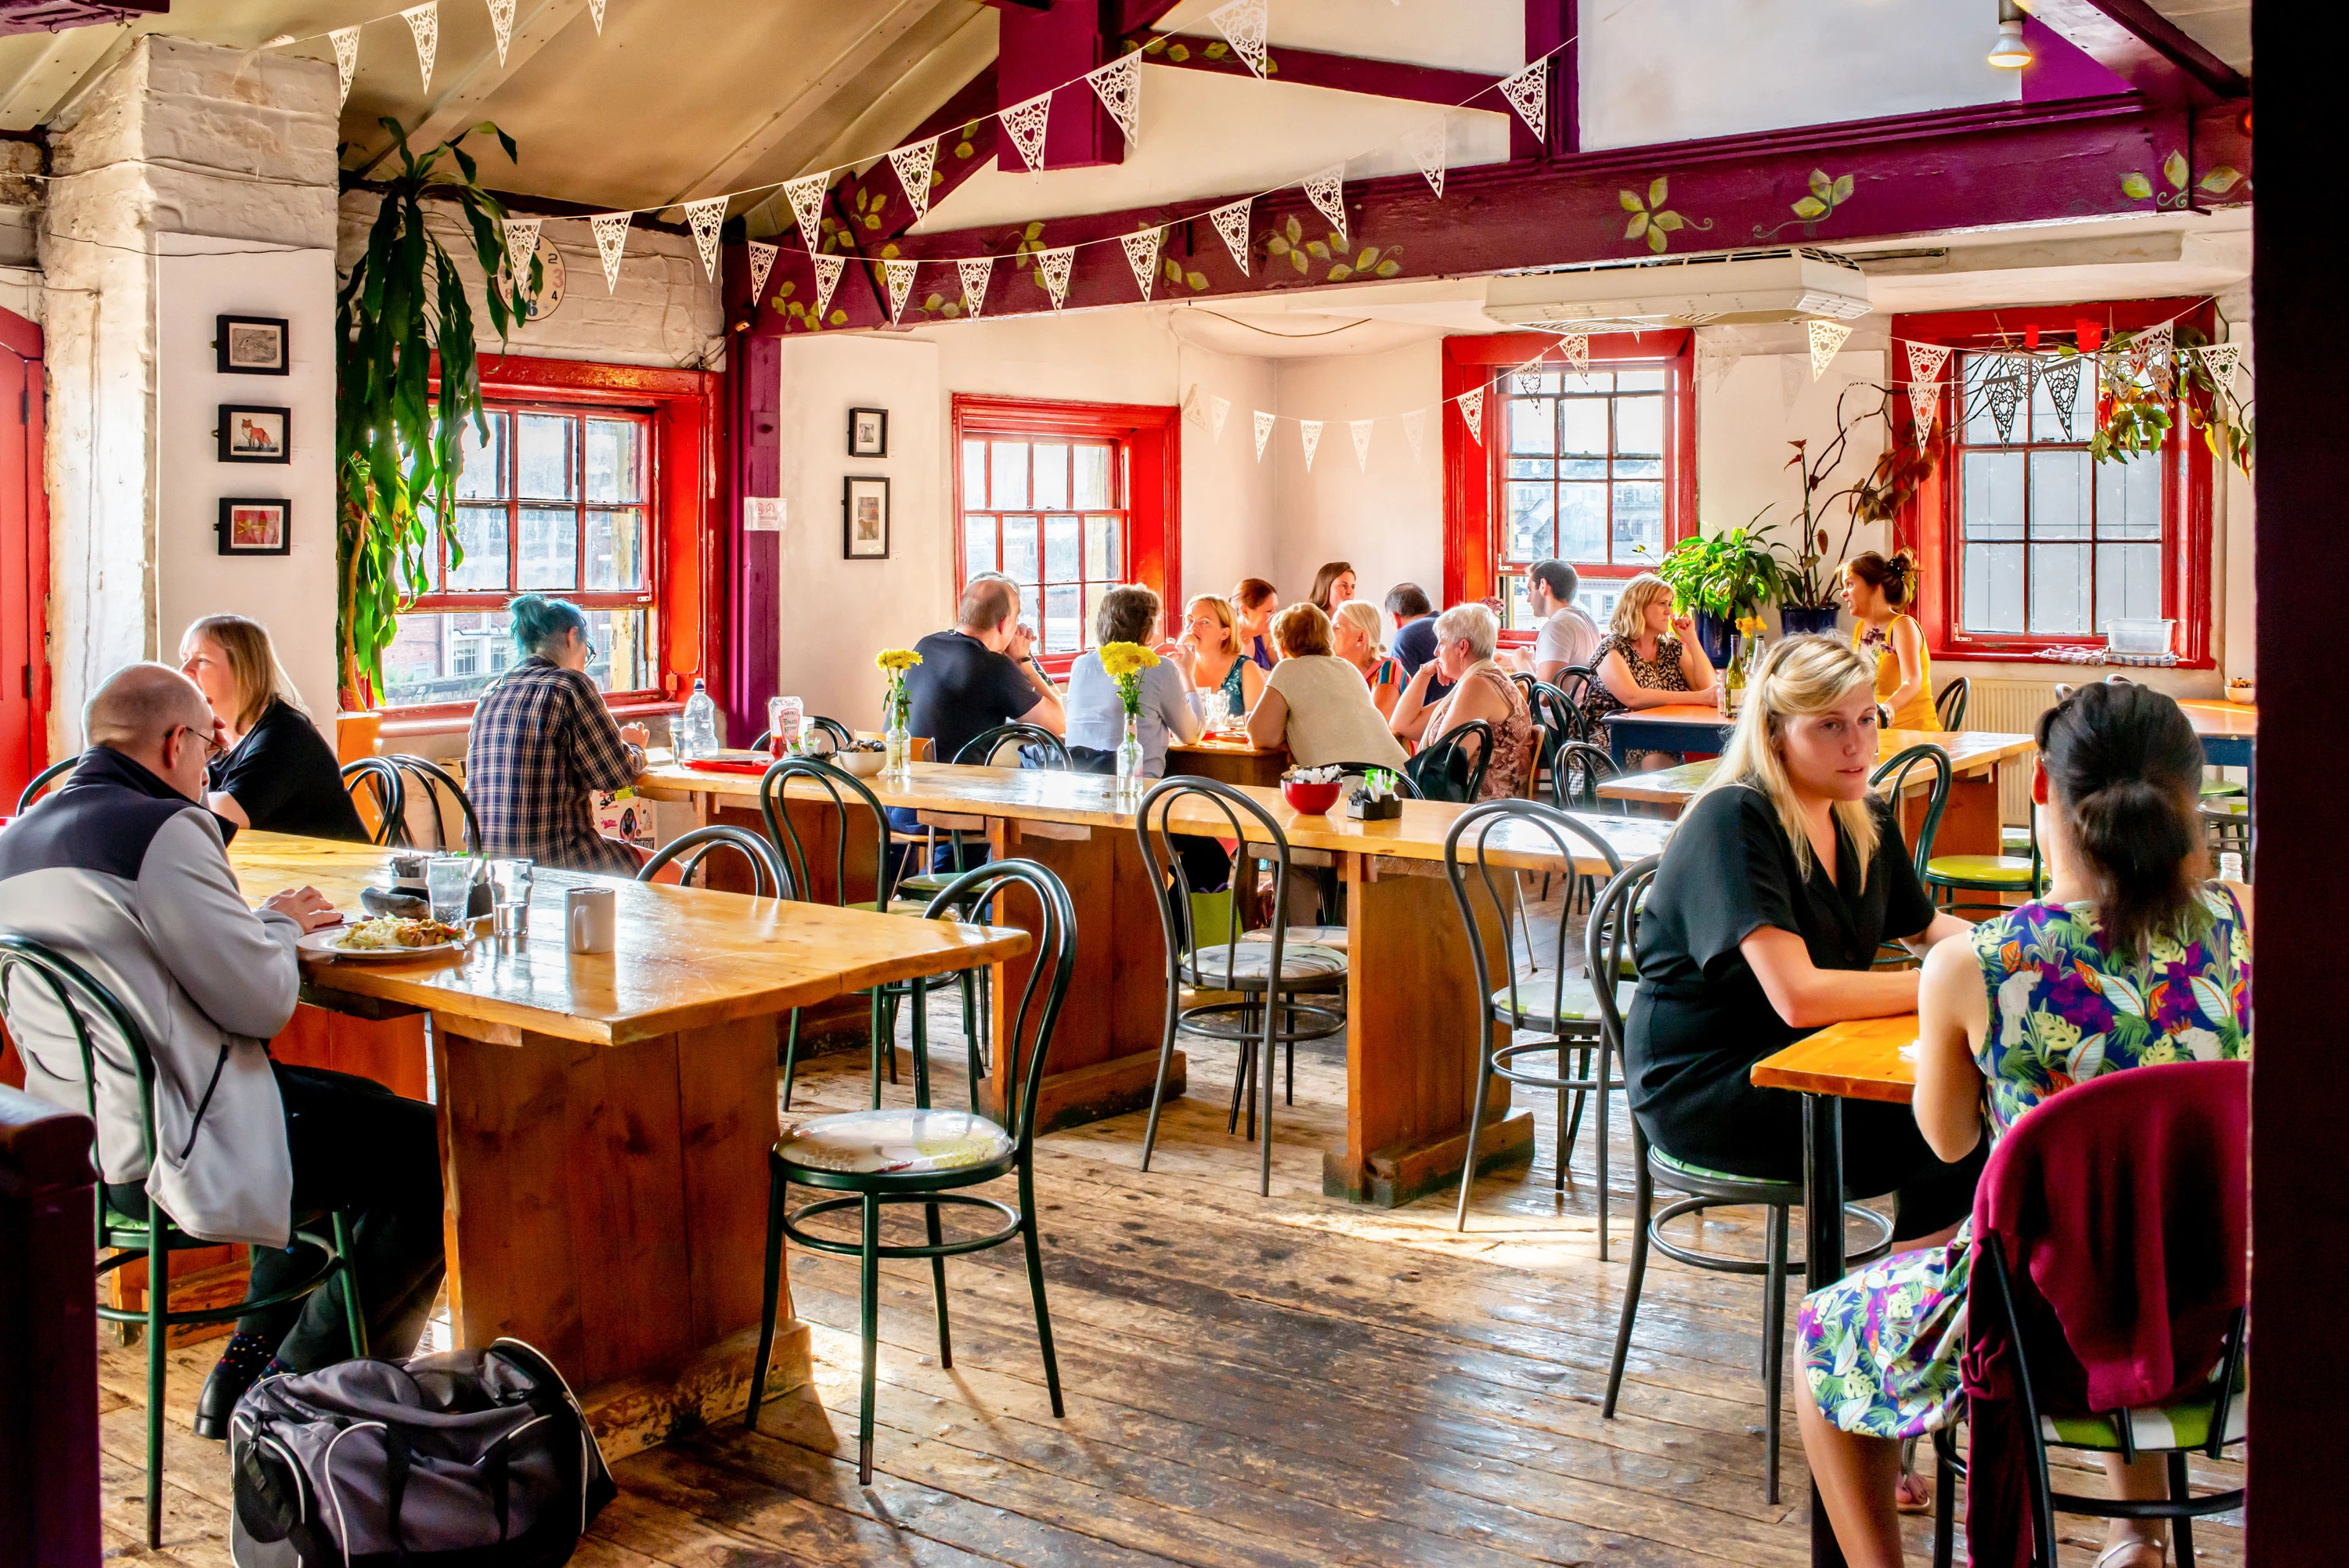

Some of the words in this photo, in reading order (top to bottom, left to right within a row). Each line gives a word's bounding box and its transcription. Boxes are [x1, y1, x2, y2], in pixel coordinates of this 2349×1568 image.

[548, 253, 558, 265] 2
[552, 268, 564, 289] 3
[505, 288, 513, 299] 8
[551, 290, 557, 301] 4
[526, 299, 538, 317] 6
